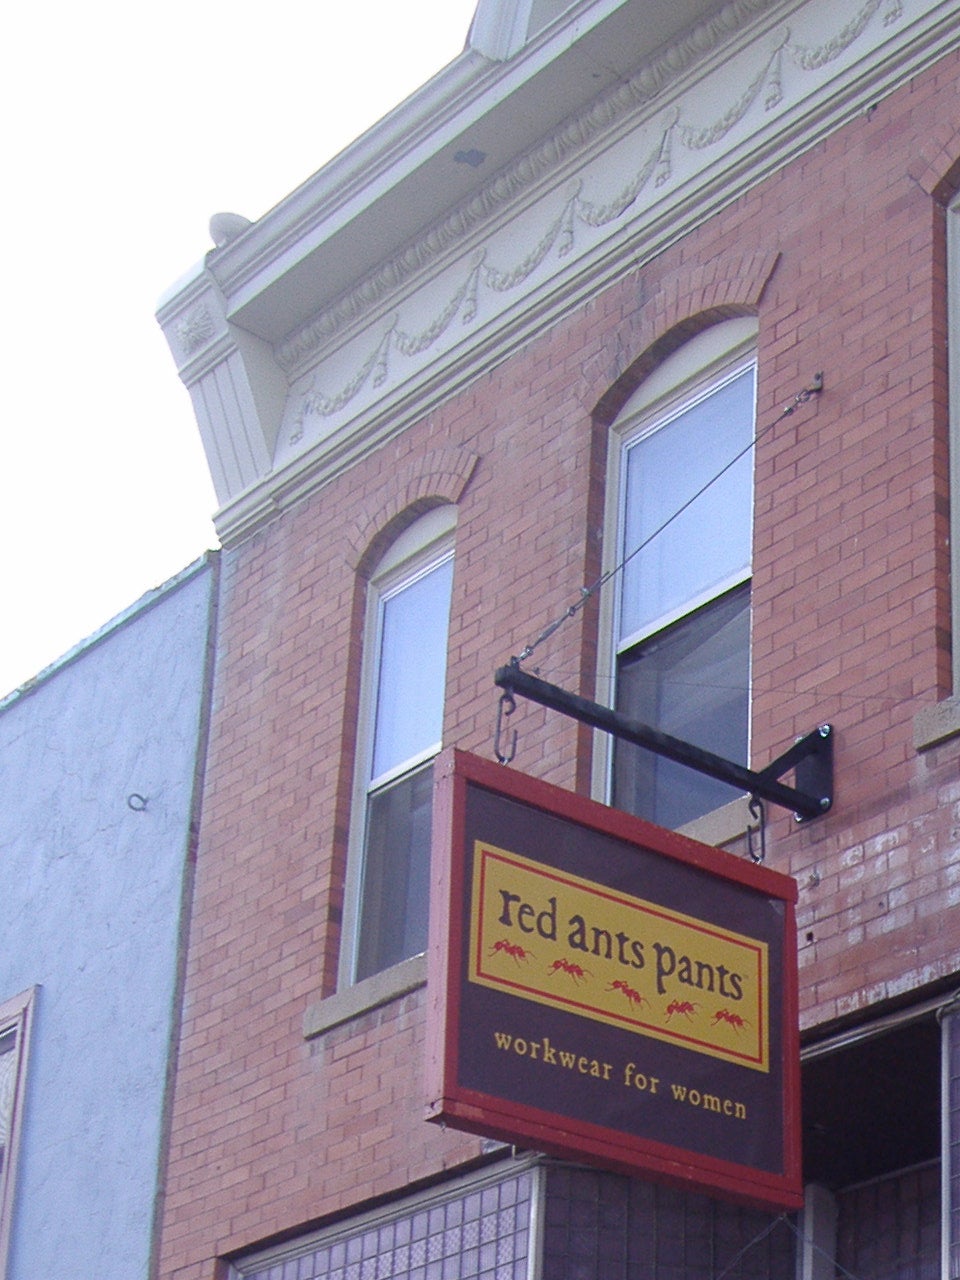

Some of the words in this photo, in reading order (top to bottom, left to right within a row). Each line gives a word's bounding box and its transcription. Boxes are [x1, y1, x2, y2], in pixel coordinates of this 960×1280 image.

[498, 889, 558, 942] red
[567, 914, 645, 969] ants
[652, 942, 743, 1001] pants
[494, 1031, 614, 1080] workwear
[624, 1062, 660, 1094] for
[671, 1084, 747, 1119] women
